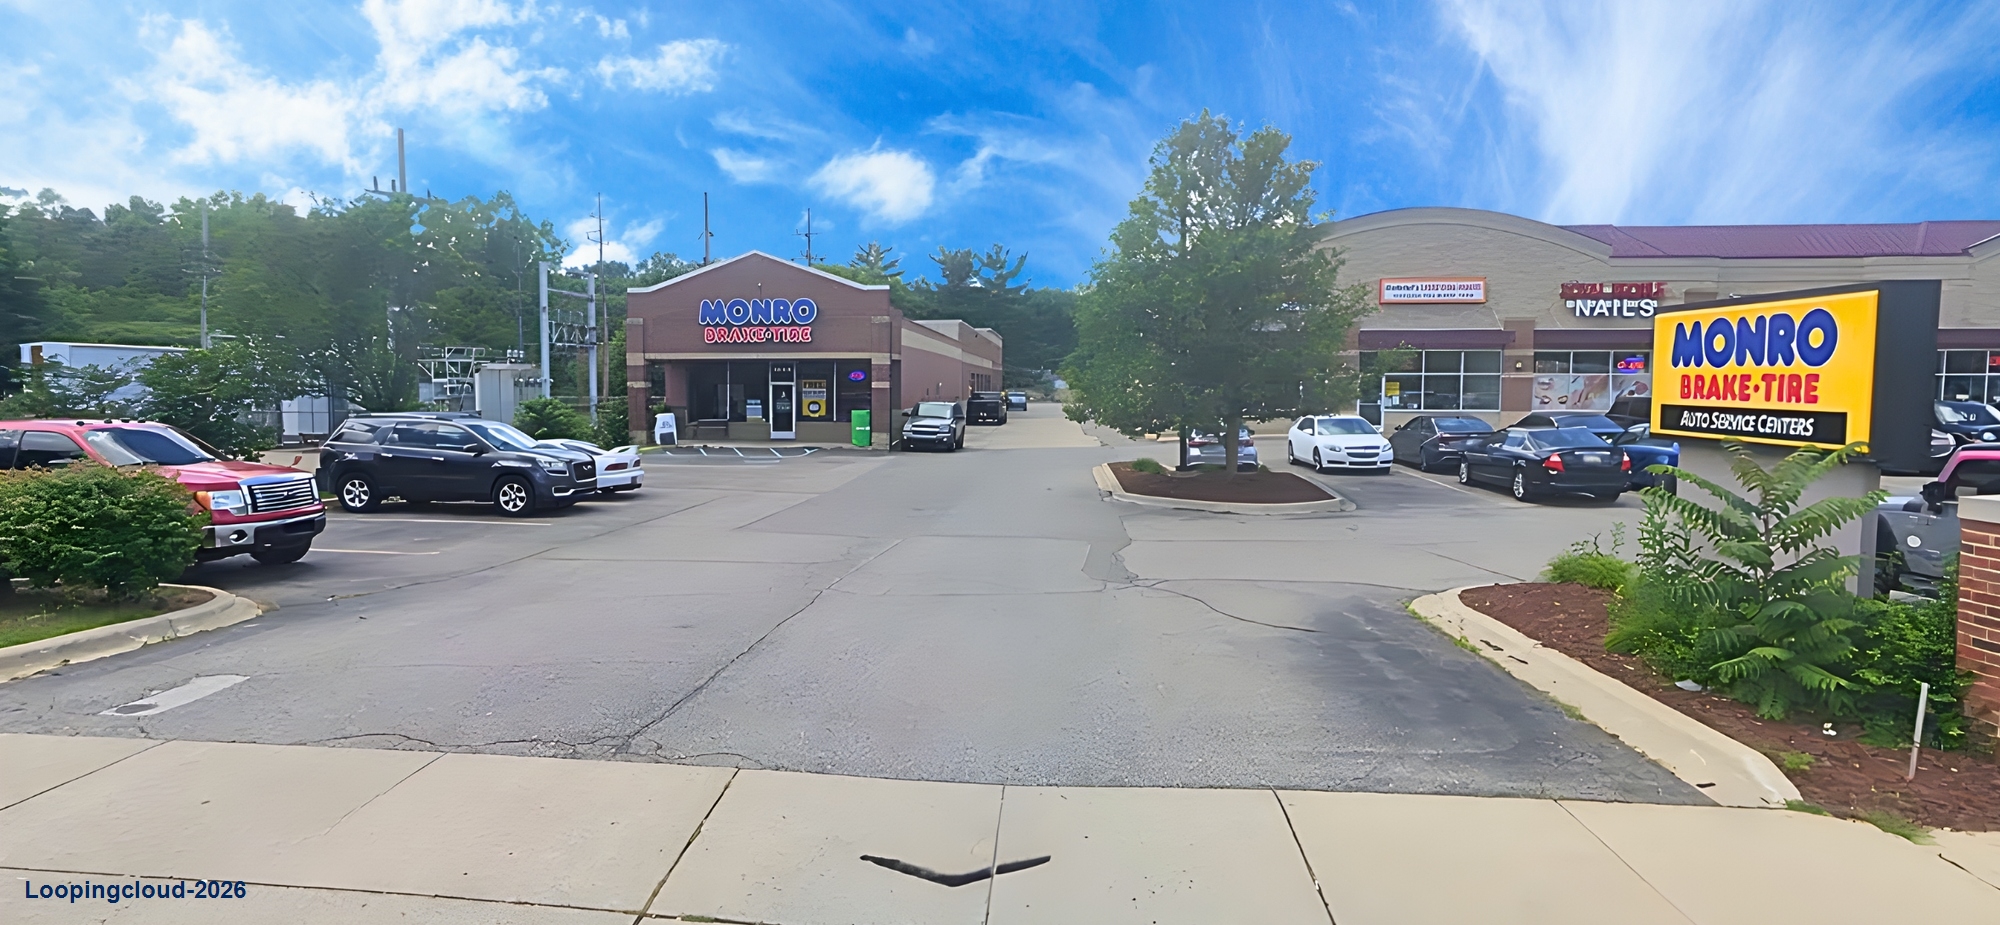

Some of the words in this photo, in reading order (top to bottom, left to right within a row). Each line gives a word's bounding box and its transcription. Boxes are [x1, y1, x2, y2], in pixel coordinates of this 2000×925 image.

[698, 297, 818, 325] MONRO
[1575, 299, 1655, 317] NAILS
[1671, 307, 1839, 369] MONRO
[1680, 410, 1710, 427] AUTO
